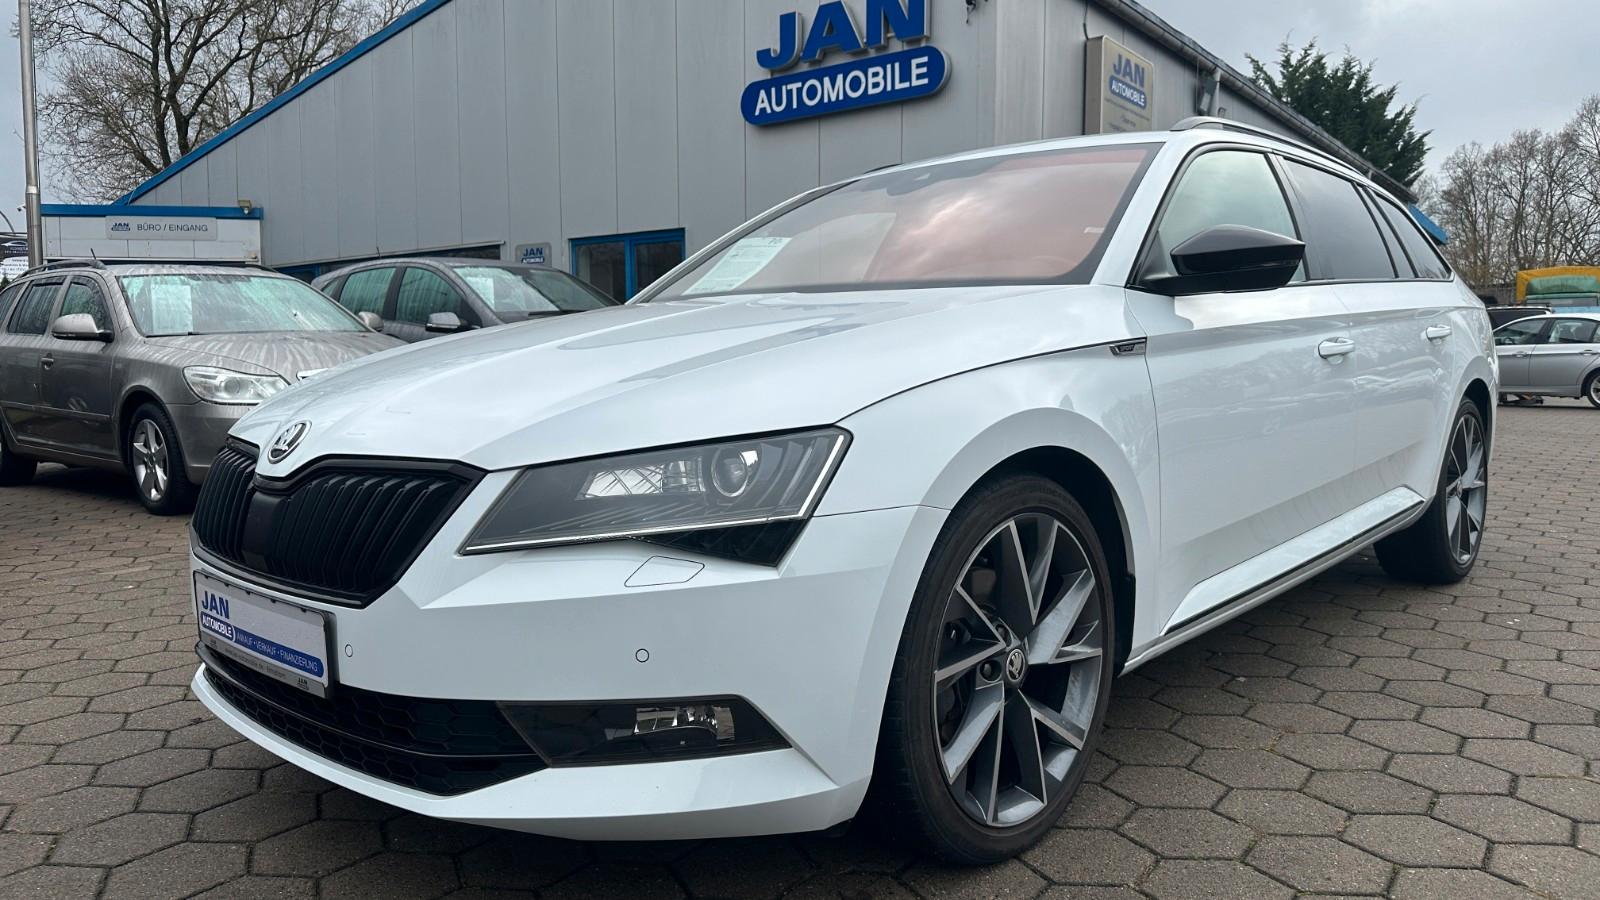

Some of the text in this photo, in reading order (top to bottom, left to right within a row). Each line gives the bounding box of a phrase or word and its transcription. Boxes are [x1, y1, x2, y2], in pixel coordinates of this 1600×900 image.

[756, 0, 926, 71] JAN
[1113, 53, 1145, 88] JAN
[755, 56, 929, 116] AUTOMOBILE
[1111, 80, 1145, 107] AUTOMOBILE
[137, 222, 161, 232] BÜRO
[169, 224, 208, 232] EINGANG
[524, 248, 543, 256] JAN
[201, 591, 230, 619] JAN
[202, 615, 232, 638] AUTOMOBILE
[279, 651, 318, 672] FINANZIERUNG
